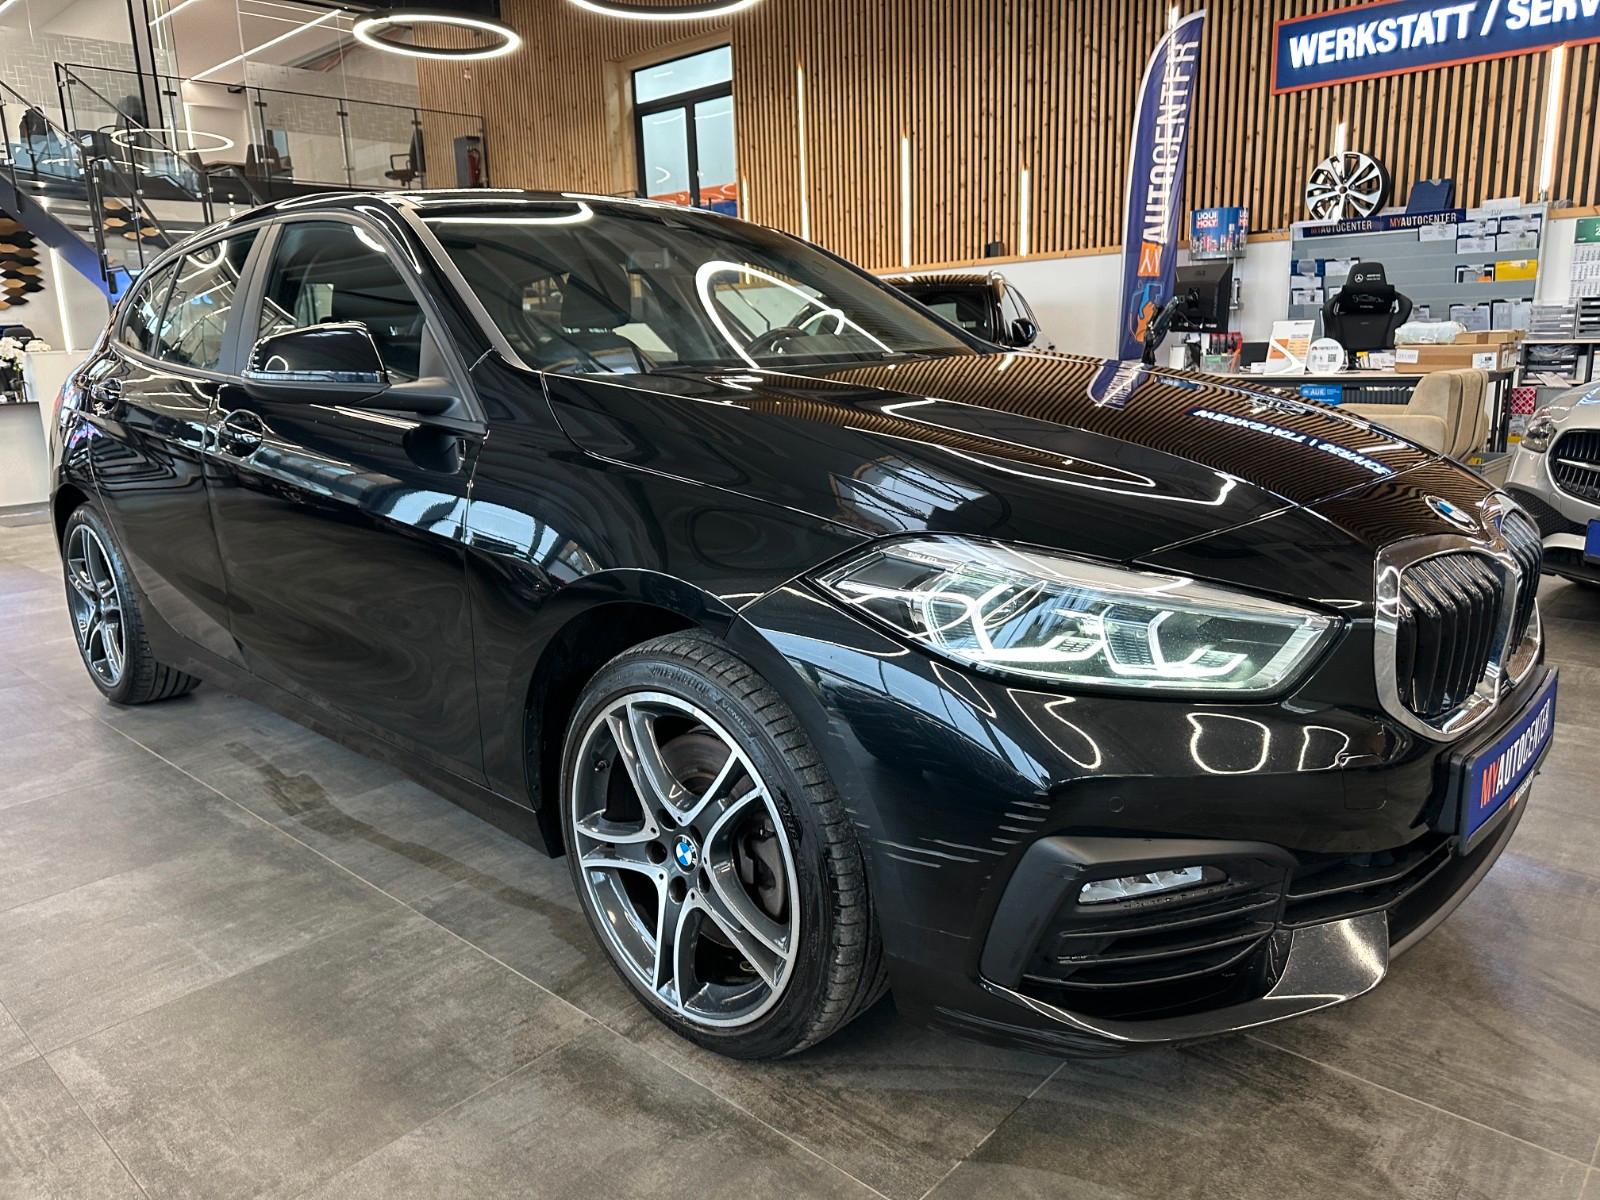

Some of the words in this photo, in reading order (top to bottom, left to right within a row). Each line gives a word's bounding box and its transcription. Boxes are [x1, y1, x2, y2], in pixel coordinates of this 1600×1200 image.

[1289, 2, 1478, 69] WERKSTATT
[1197, 211, 1217, 220] LIQUI
[1389, 212, 1457, 228] MYAUTOCENTER
[1197, 220, 1217, 229] MOLY
[1480, 698, 1551, 809] MYAUTOCENTER
